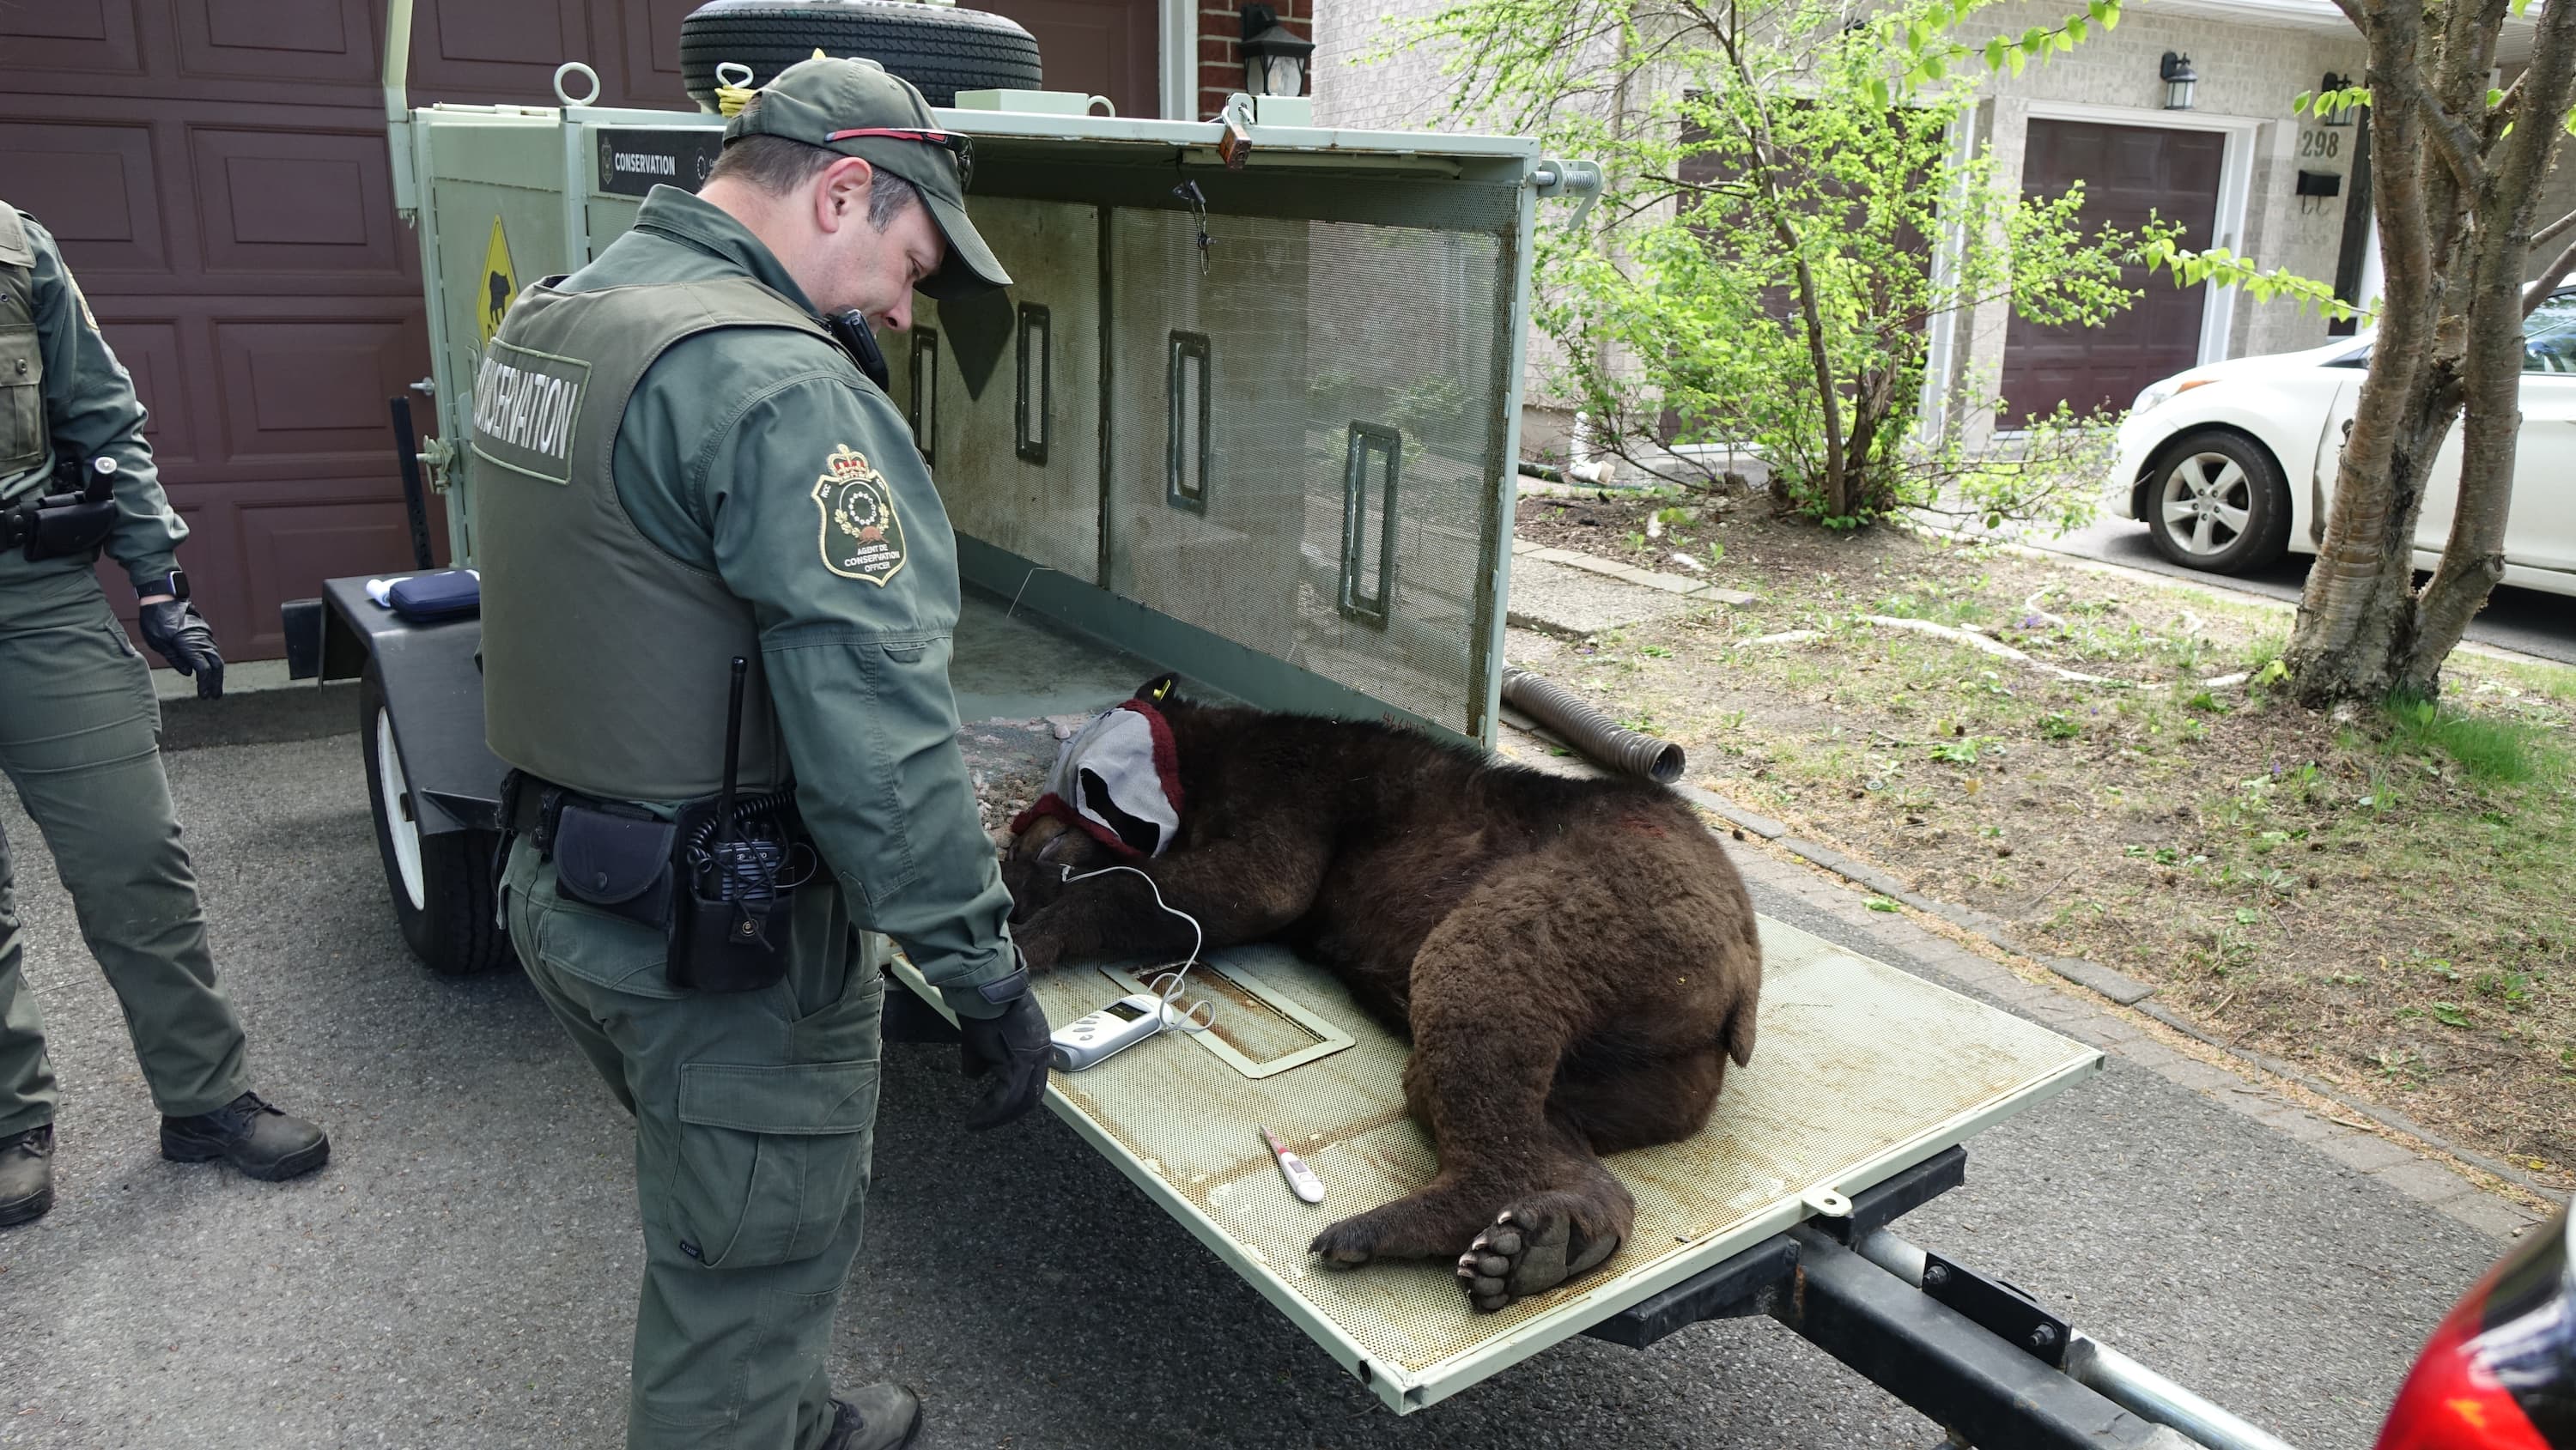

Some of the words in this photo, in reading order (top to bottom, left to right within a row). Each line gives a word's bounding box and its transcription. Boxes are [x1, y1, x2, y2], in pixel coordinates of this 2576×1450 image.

[2301, 130, 2339, 158] 298
[615, 153, 675, 175] CONSERVATION
[474, 356, 578, 459] ONSERVATION
[844, 550, 900, 567] CONSERVATION
[857, 546, 878, 555] AGENT
[865, 561, 890, 573] OFFICER
